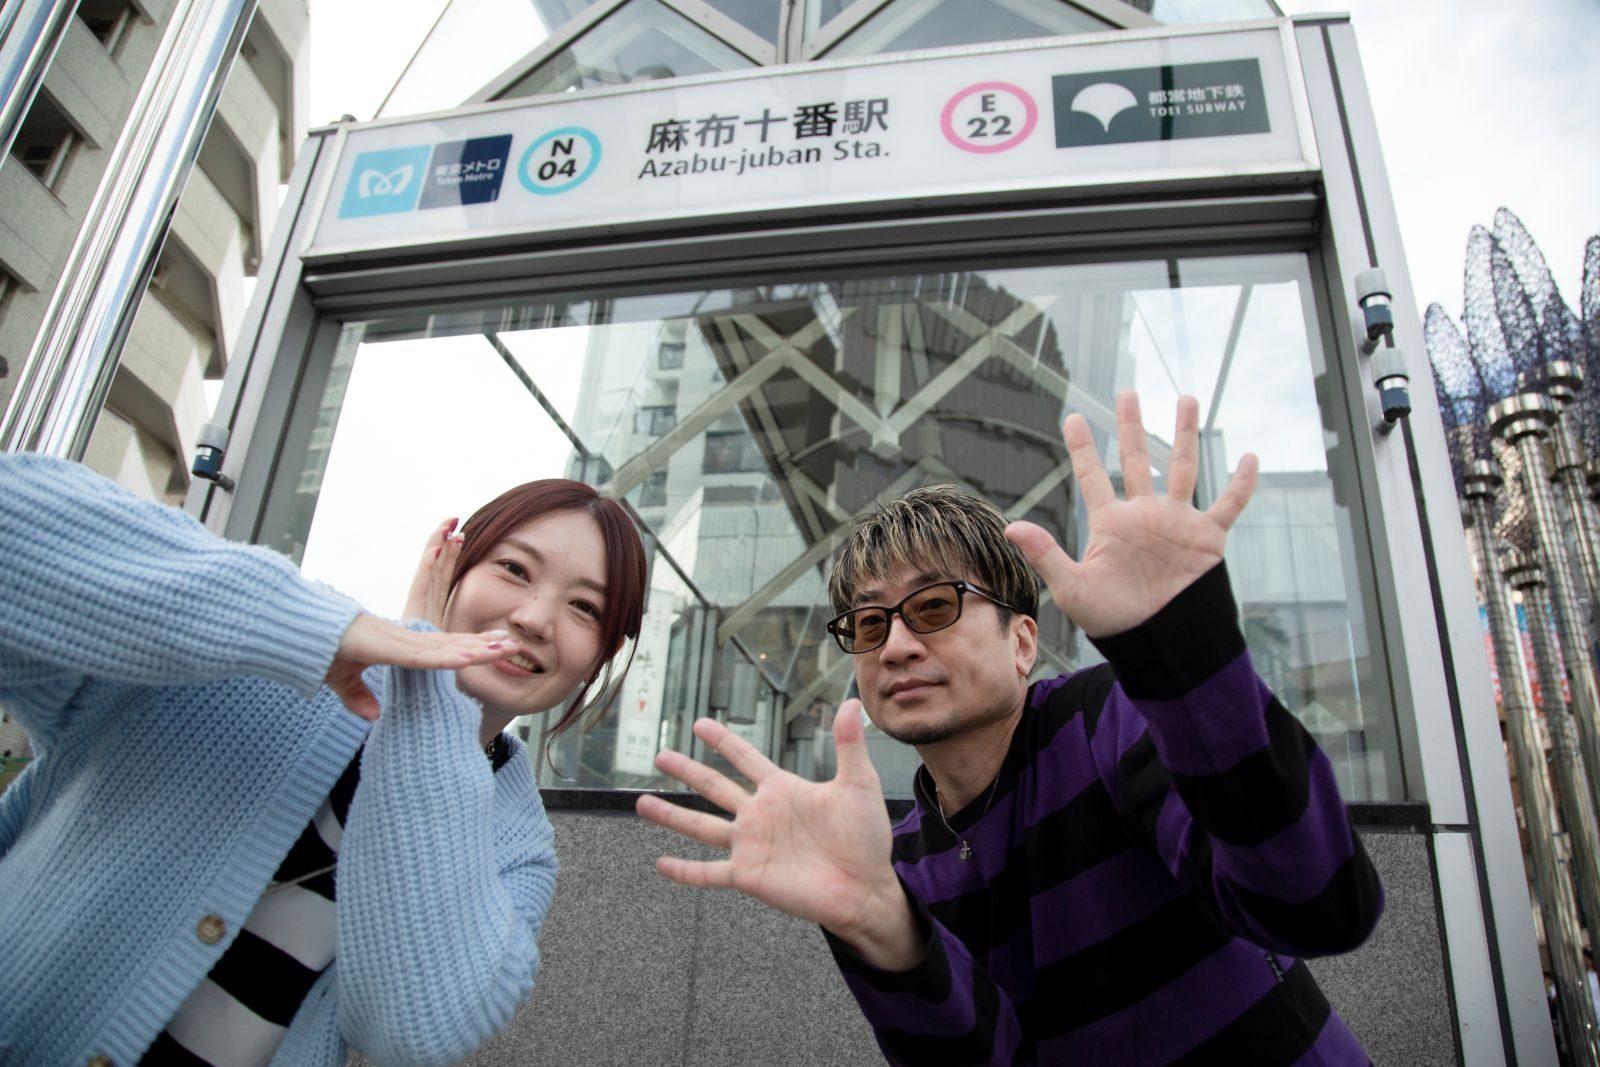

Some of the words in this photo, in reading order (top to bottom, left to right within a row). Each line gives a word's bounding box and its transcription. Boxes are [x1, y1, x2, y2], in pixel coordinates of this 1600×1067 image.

[981, 94, 996, 112] E
[1148, 84, 1246, 105] 都営地下鉄
[1150, 105, 1181, 118] TOEI
[1187, 100, 1247, 115] SUBWAY
[645, 98, 889, 154] 麻布十番駅
[967, 115, 1012, 139] 22
[551, 138, 574, 157] N
[435, 158, 501, 177] 東京メトロ
[638, 146, 822, 179] Azabu-juban
[834, 139, 890, 161] Sta.
[436, 175, 463, 186] Tokyo
[464, 172, 494, 183] Metro
[538, 158, 577, 181] 04
